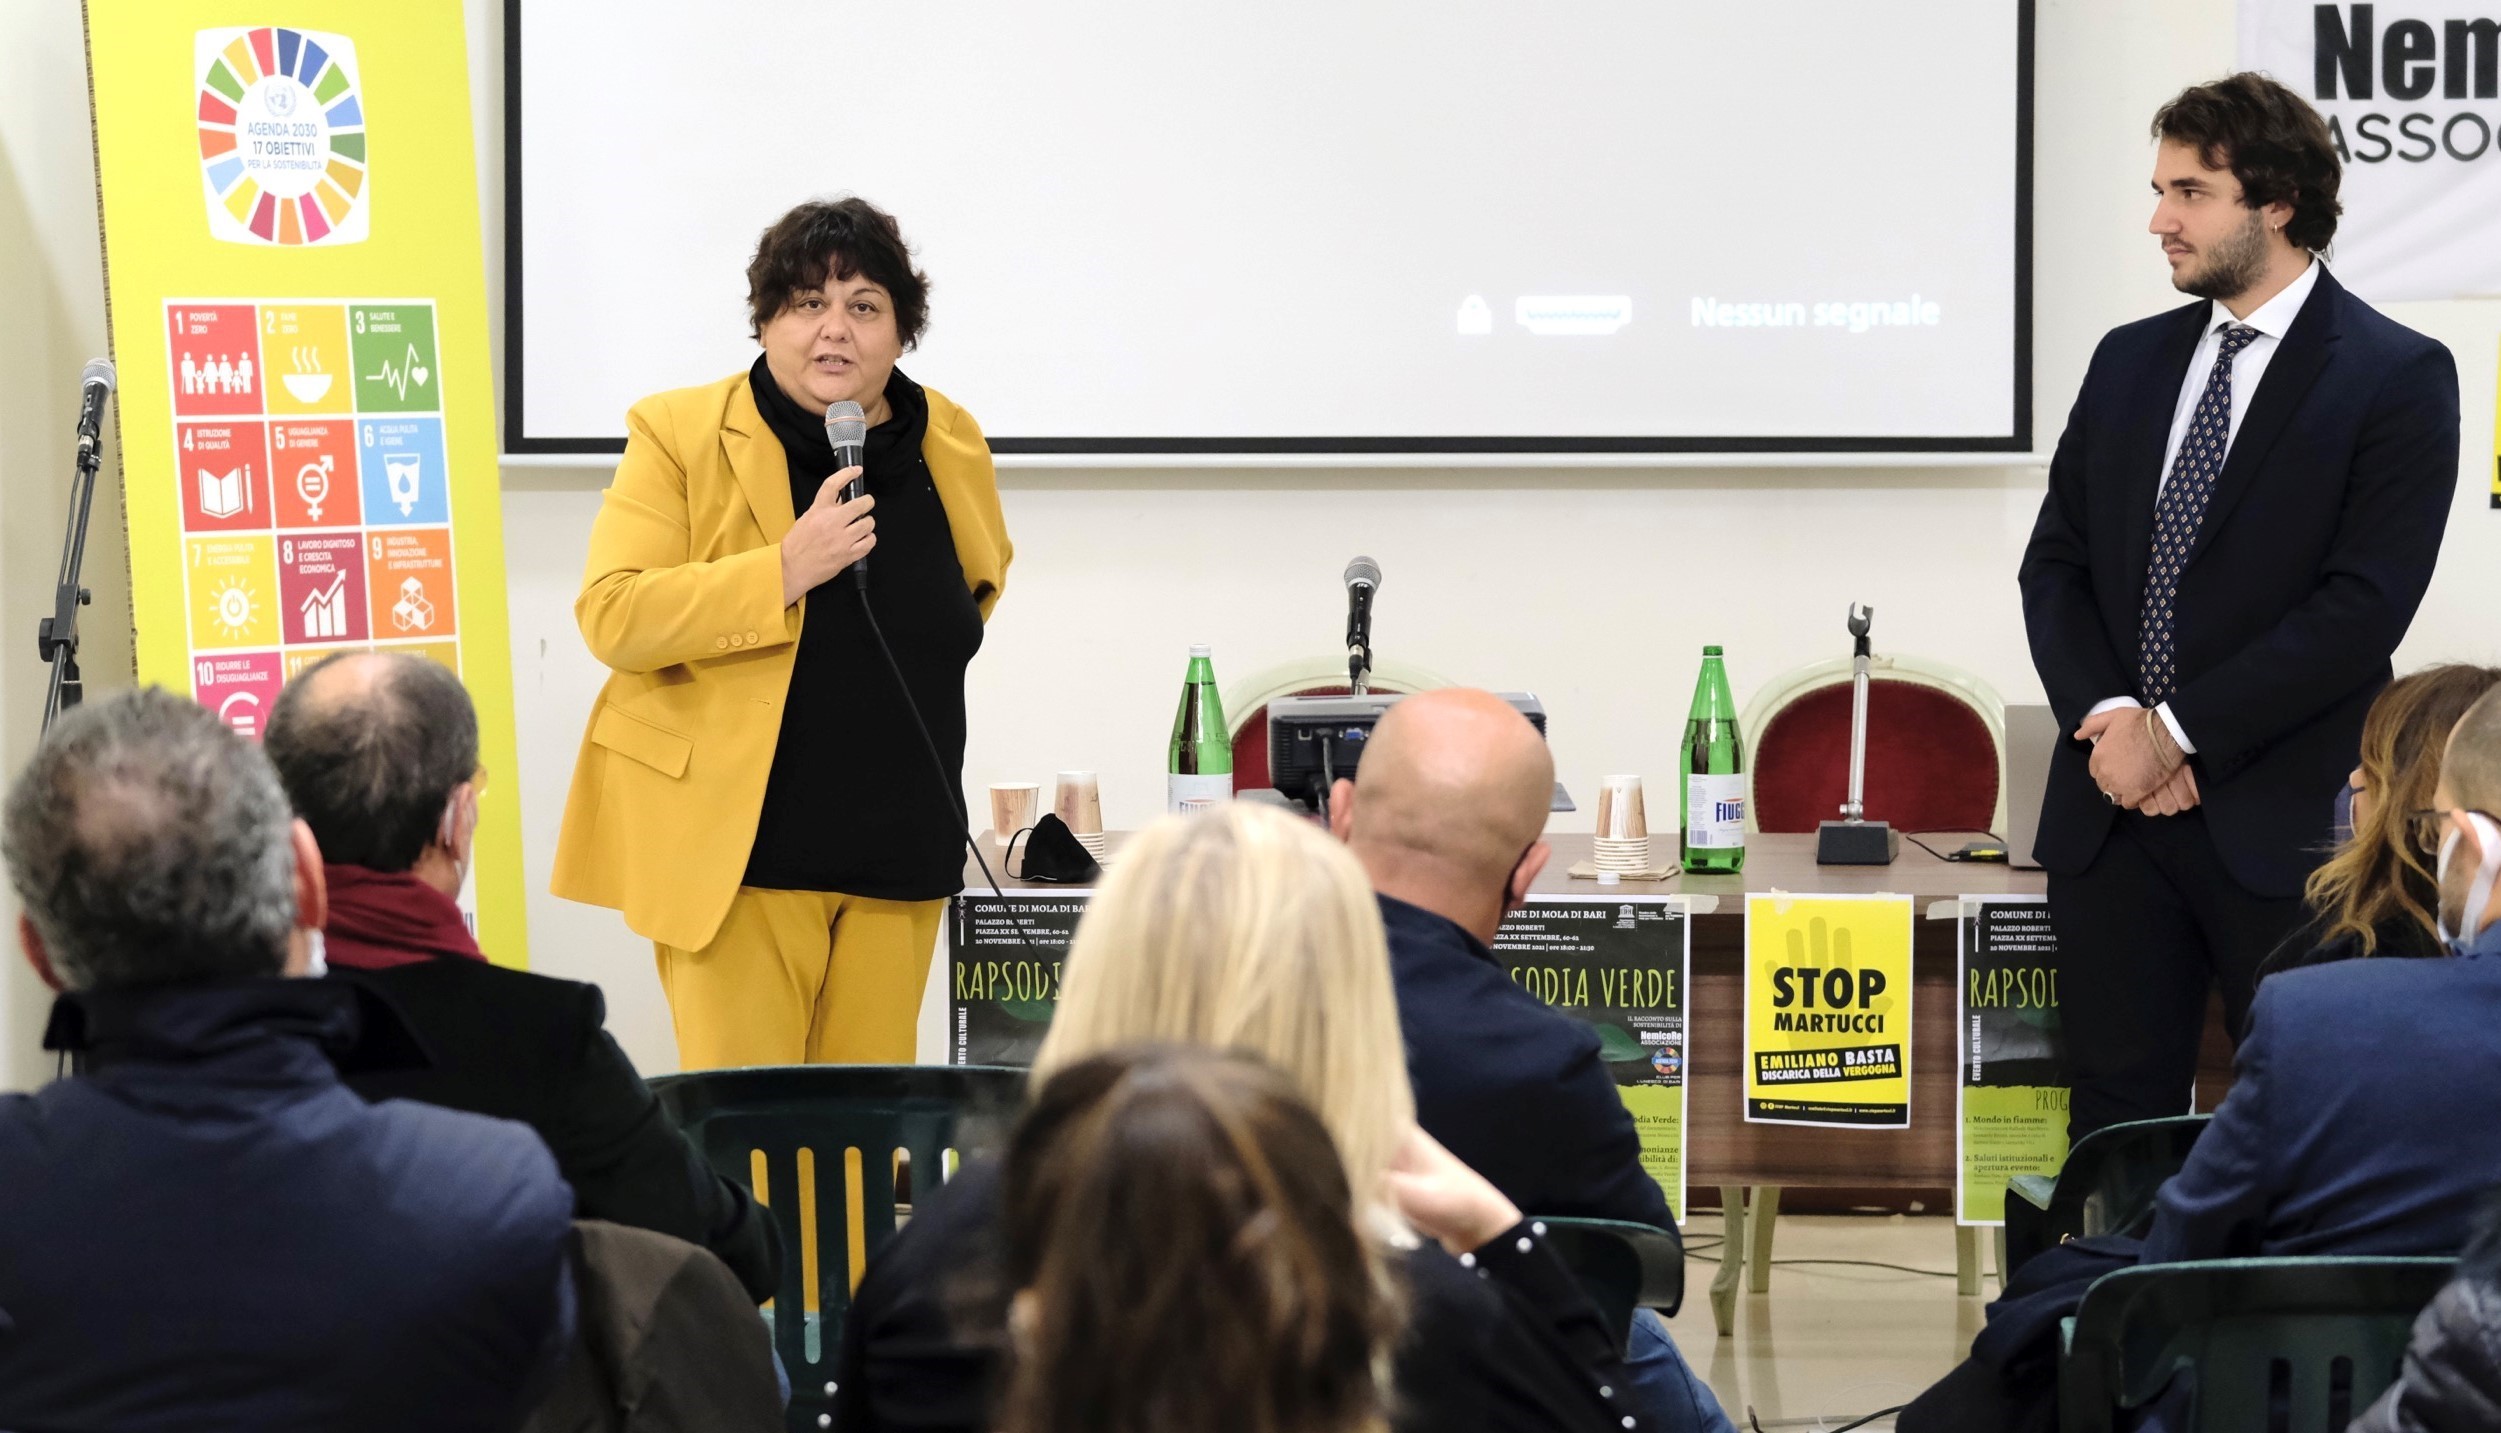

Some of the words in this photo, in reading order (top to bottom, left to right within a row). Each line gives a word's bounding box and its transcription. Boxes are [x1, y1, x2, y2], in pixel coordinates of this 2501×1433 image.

[248, 122, 290, 136] AGENDA
[292, 123, 318, 137] 2030
[2328, 112, 2501, 163] ASSO
[253, 141, 263, 154] 17
[266, 141, 315, 156] OBIETTIVI
[248, 160, 261, 169] PER
[262, 160, 271, 169] LA
[175, 311, 184, 334] 1
[266, 311, 276, 334] 2
[355, 311, 365, 334] 3
[369, 312, 390, 321] SALUTE
[1691, 296, 1805, 327] Nessun
[1813, 294, 1941, 333] segnale
[190, 324, 208, 334] ZERO
[183, 428, 194, 451] 4
[197, 429, 231, 438] ISTRUZIONE
[274, 426, 285, 449] 5
[364, 425, 374, 447] 6
[283, 540, 294, 564] 8
[298, 540, 322, 549] LAVORO
[323, 538, 355, 548] DIGNITOSO
[372, 537, 382, 560] 9
[192, 545, 202, 567] 7
[304, 551, 332, 562] CRESCITA
[299, 563, 336, 574] ECONOMICA
[197, 661, 214, 686] 10
[216, 661, 241, 671] RIDURRE
[242, 660, 250, 670] LE
[216, 672, 268, 683] DISUGUAGLIANZE
[974, 904, 1017, 913] COMUE
[1019, 904, 1029, 913] DI
[1031, 904, 1058, 913] MOLA
[1060, 904, 1071, 913] DI
[1072, 904, 1092, 913] BAR
[1506, 910, 1527, 919] UNE
[1529, 910, 1540, 919] DI
[1541, 910, 1569, 919] MOLA
[1570, 911, 1581, 919] DI
[1583, 911, 1606, 919] BARI
[1990, 911, 2034, 919] COMUNE
[2035, 911, 2046, 919] DI
[956, 961, 1062, 1001] RAPSODI
[1510, 966, 1589, 1007] SODIA
[1600, 968, 1677, 1008] VERDE
[1773, 966, 1886, 1009] STOP
[958, 1007, 967, 1046] CULTURALE
[1774, 1012, 1884, 1033] MARTUCCI
[1640, 1031, 1682, 1040] NemicoRe
[1972, 1014, 1981, 1053] CULTURALE
[957, 1047, 967, 1065] ENTO
[1760, 1052, 1838, 1069] EMILIANO
[1845, 1049, 1895, 1066] BASTA
[1761, 1068, 1811, 1080] DISCARICA
[1813, 1067, 1841, 1079] DELLA
[1843, 1063, 1896, 1077] VERGOGNA
[1972, 1054, 1981, 1081] EVENTO
[2035, 1090, 2068, 1111] PROG
[1652, 1115, 1679, 1124] Verde:
[1973, 1115, 2002, 1124] Mondo
[2003, 1115, 2012, 1124] in
[2013, 1115, 2048, 1124] fiamme:
[1973, 1154, 1998, 1162] Saluti
[1999, 1154, 2049, 1162] istituzionali
[1973, 1164, 2009, 1172] apertura
[2010, 1163, 2041, 1171] evento:
